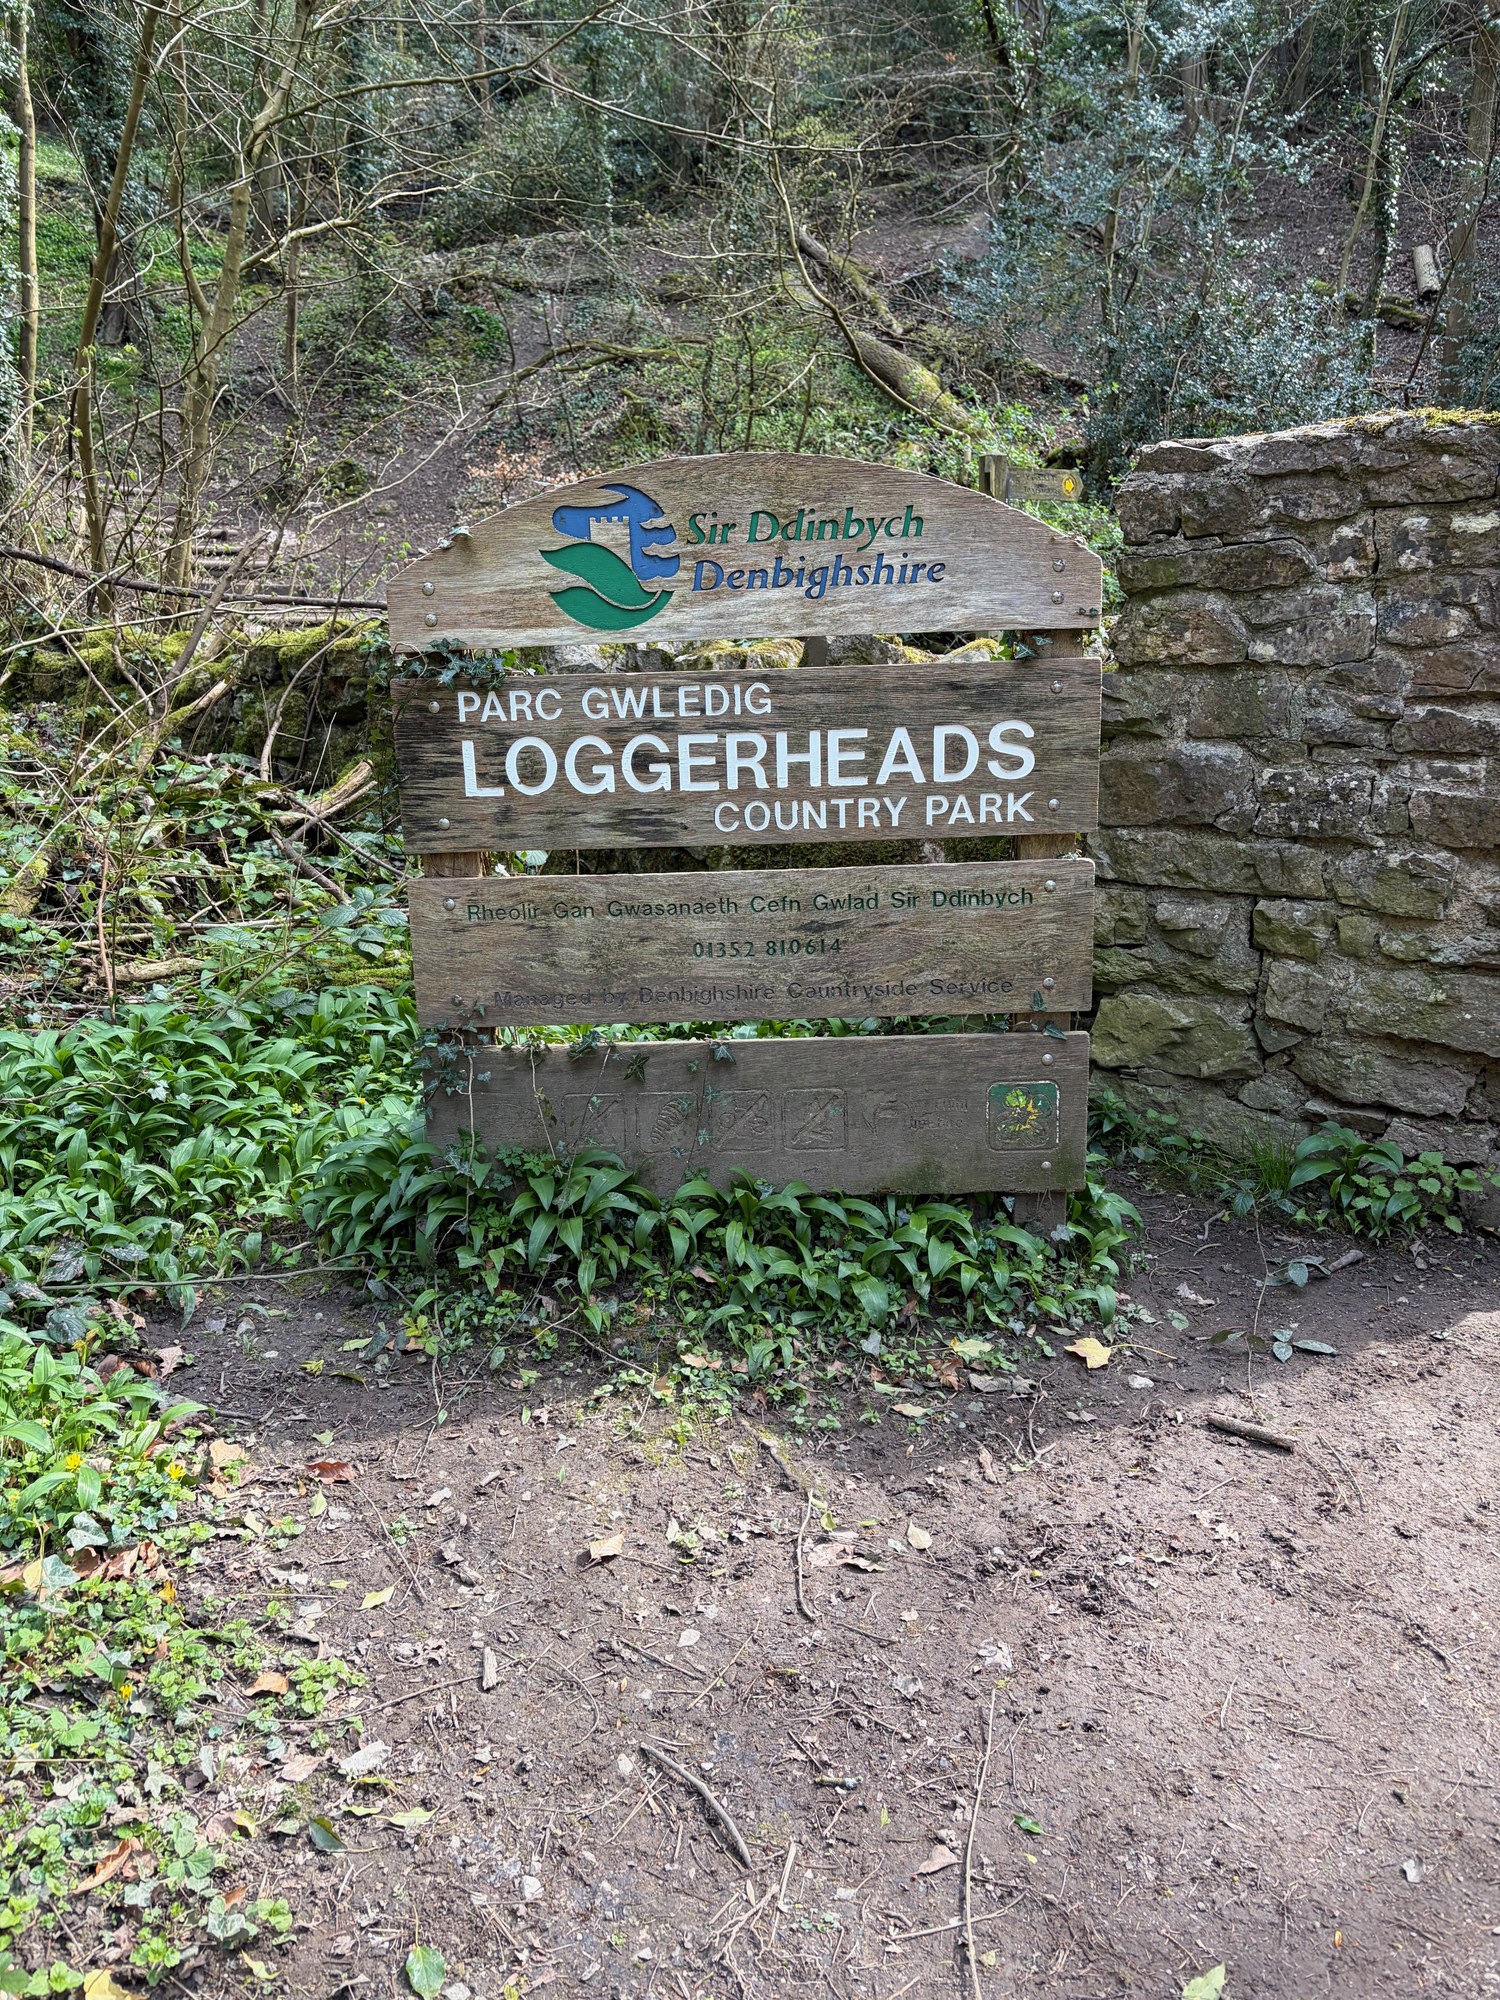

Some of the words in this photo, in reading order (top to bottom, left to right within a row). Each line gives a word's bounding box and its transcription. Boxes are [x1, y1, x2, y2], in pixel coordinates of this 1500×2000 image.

[687, 511, 737, 545] Sir
[747, 505, 924, 551] Ddinbych
[692, 553, 946, 600] Denbighshire
[458, 687, 563, 722] PARC
[581, 682, 772, 719] GWLEDIG
[461, 720, 1036, 798] LOGGERHEADS
[713, 797, 907, 832] COUNTRY
[926, 791, 1035, 827] PARK
[467, 903, 541, 921] Rheolir
[553, 901, 595, 919] Gan
[607, 898, 739, 918] Gwasanaeth
[750, 895, 801, 913] Cefn
[813, 893, 879, 911] Gwlad
[890, 890, 920, 909] Sir
[932, 887, 1033, 908] Ddinbych
[692, 941, 755, 959] 01352
[766, 938, 842, 957] 810614
[494, 988, 591, 1009] Managed
[603, 987, 627, 1008] by
[639, 984, 776, 1006] Denbighshire
[787, 980, 918, 1000] Countryside
[929, 977, 1014, 996] Service
